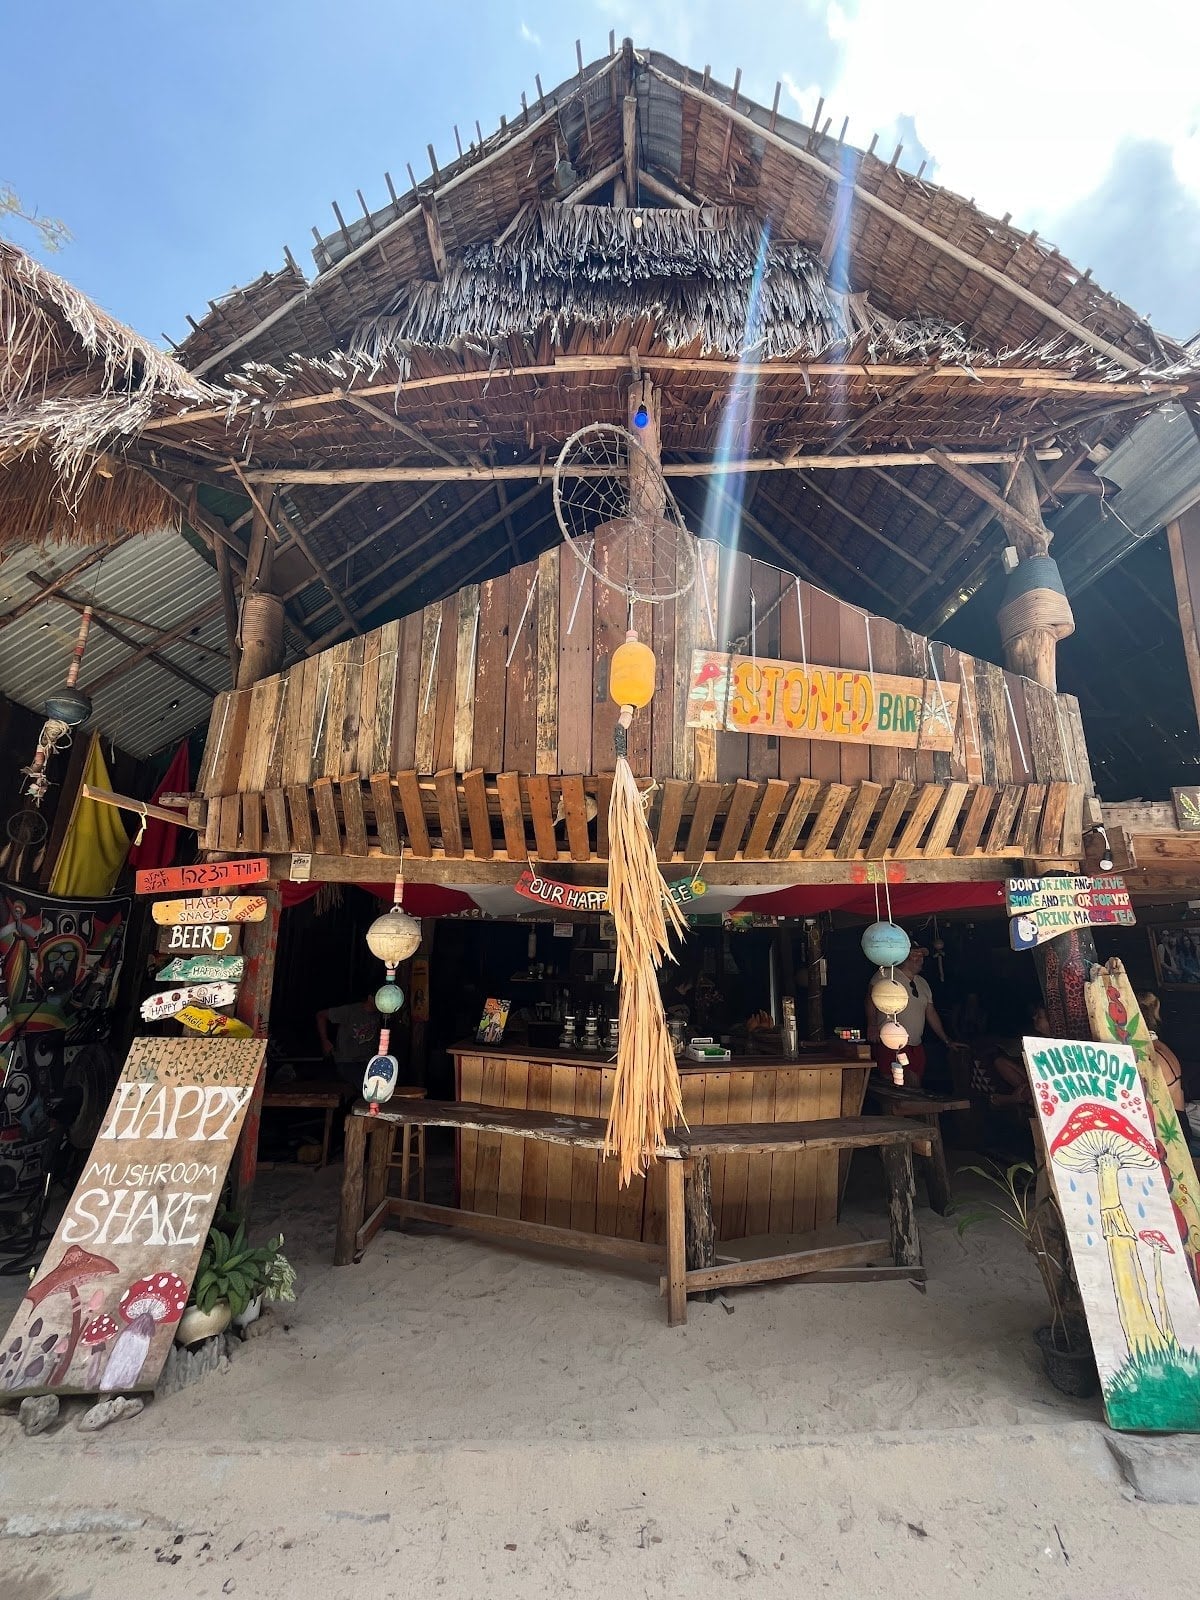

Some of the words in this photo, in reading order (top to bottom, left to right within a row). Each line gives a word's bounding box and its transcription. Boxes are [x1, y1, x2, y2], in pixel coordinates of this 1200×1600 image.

[732, 661, 874, 735] STONED
[878, 692, 919, 733] BAR
[529, 878, 563, 904] OUR
[566, 890, 609, 909] HAPP
[1040, 879, 1074, 891] DRINK
[1092, 877, 1126, 890] DRIVE
[184, 896, 240, 911] HAPPY
[1010, 894, 1041, 907] SMOKE
[1041, 894, 1059, 907] AND
[1060, 894, 1076, 907] FLY
[1077, 894, 1093, 907] OR
[1093, 894, 1114, 906] FOR
[1112, 894, 1130, 906] VIP
[179, 909, 229, 922] SNACKS
[1036, 911, 1074, 927] DRINK
[1111, 909, 1135, 923] TEA
[168, 925, 212, 949] BEER
[151, 1002, 177, 1016] HAPPY
[180, 1012, 204, 1028] MAGIC
[1032, 1044, 1137, 1091] MUSHROOM
[1052, 1073, 1118, 1103] SHAKE
[101, 1083, 253, 1140] HAPPY
[81, 1162, 219, 1187] MUSHROOM
[62, 1188, 213, 1246] SHAKE
